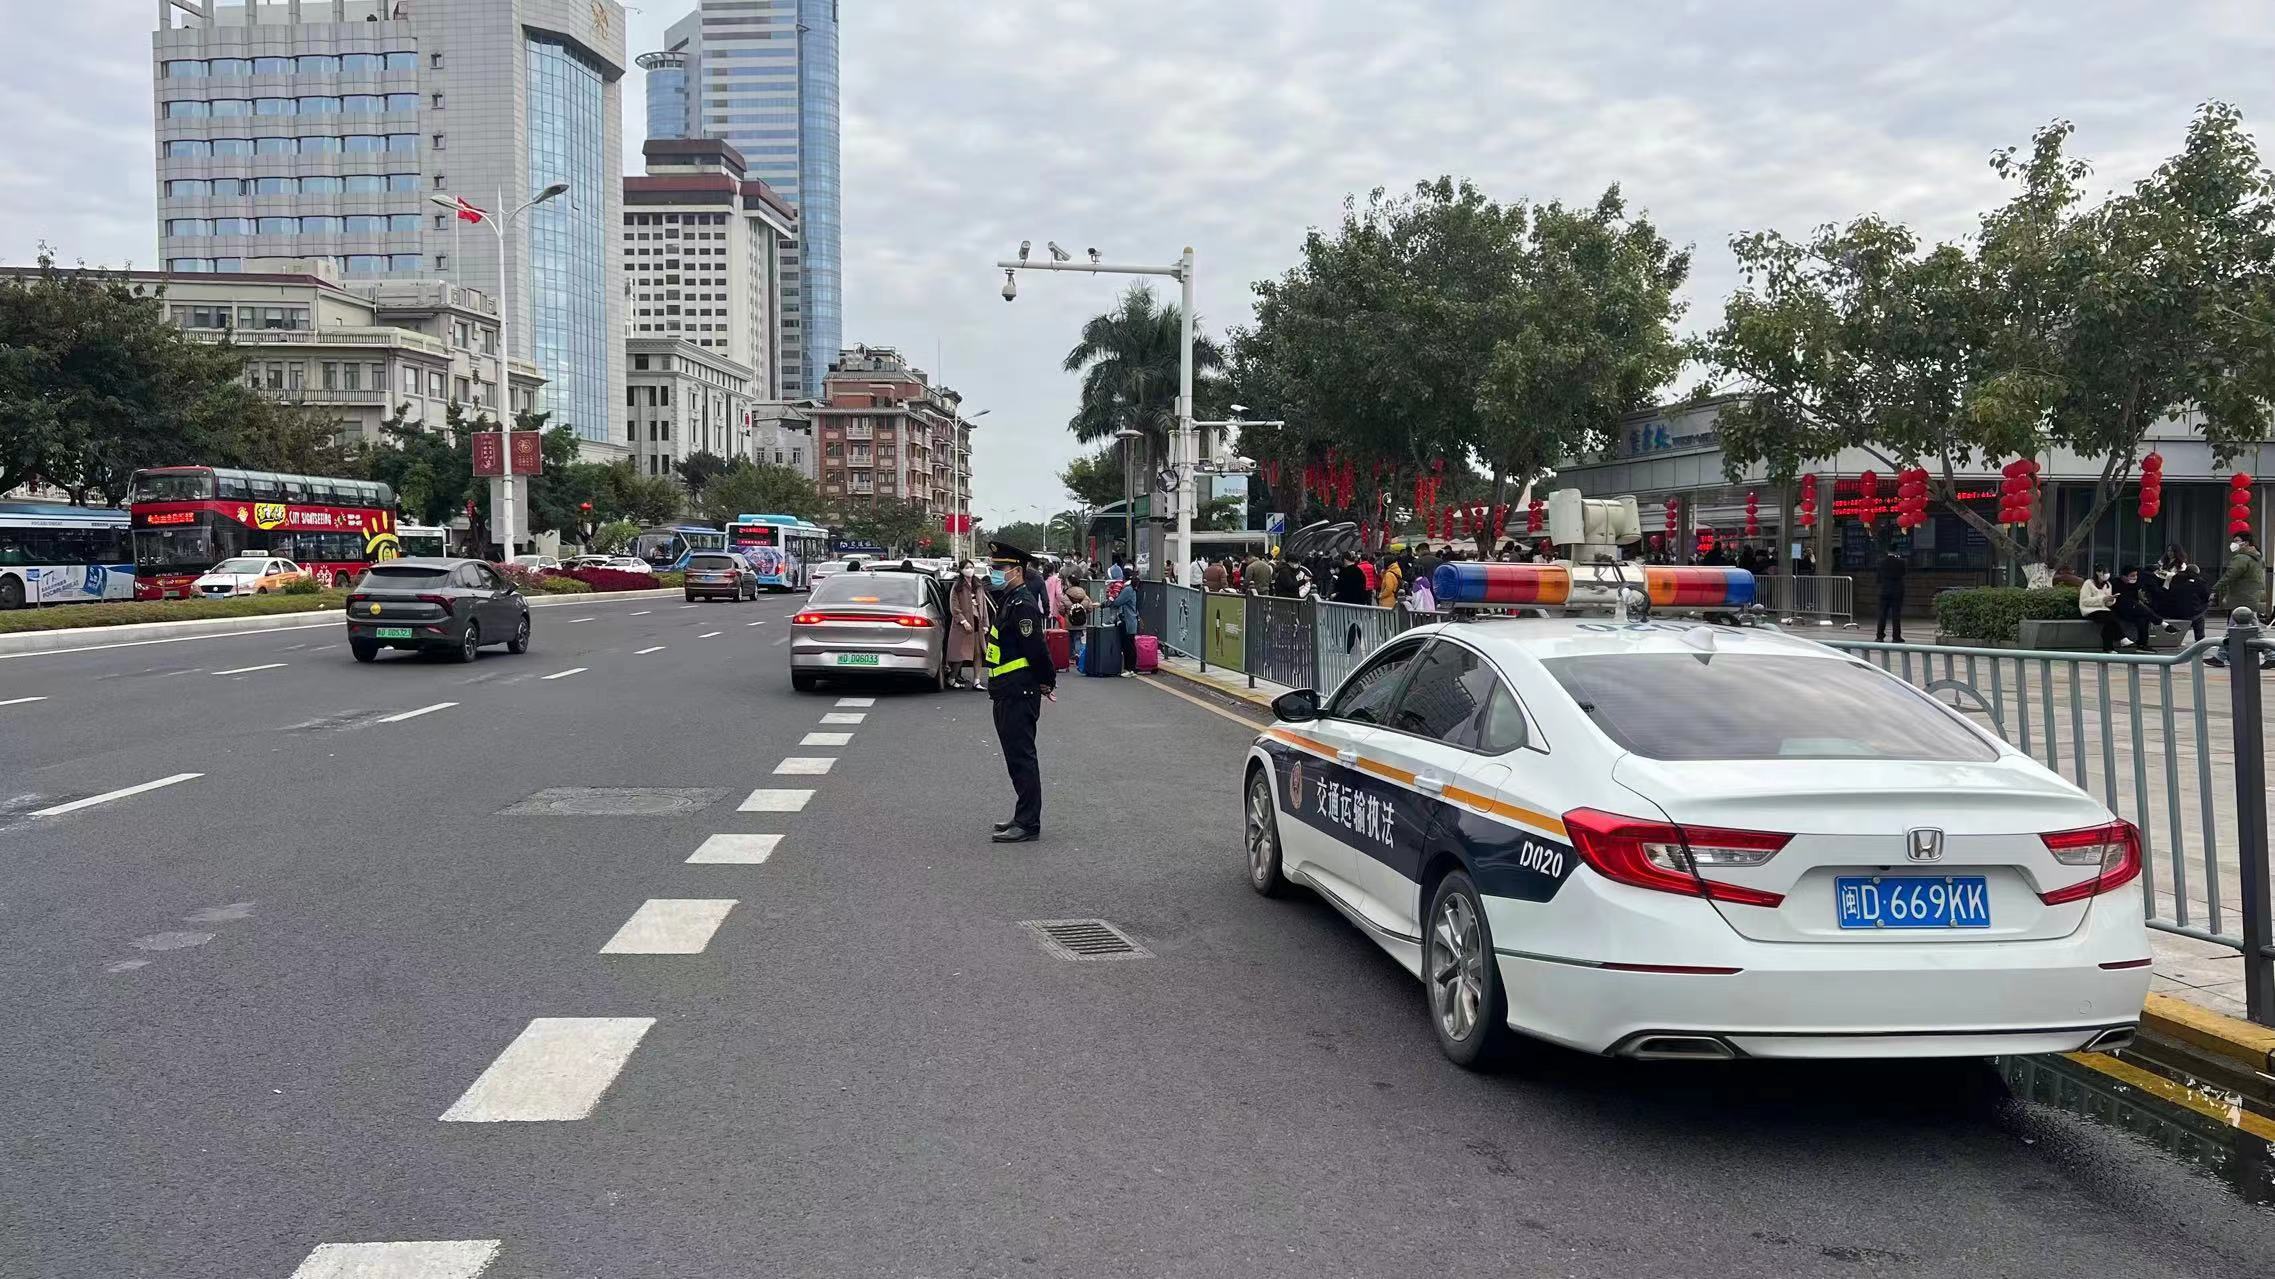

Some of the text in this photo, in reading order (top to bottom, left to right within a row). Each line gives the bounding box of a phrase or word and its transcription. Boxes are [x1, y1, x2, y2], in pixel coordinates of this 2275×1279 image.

[1316, 777, 1395, 848] 交通运输执法
[1519, 841, 1564, 879] D020
